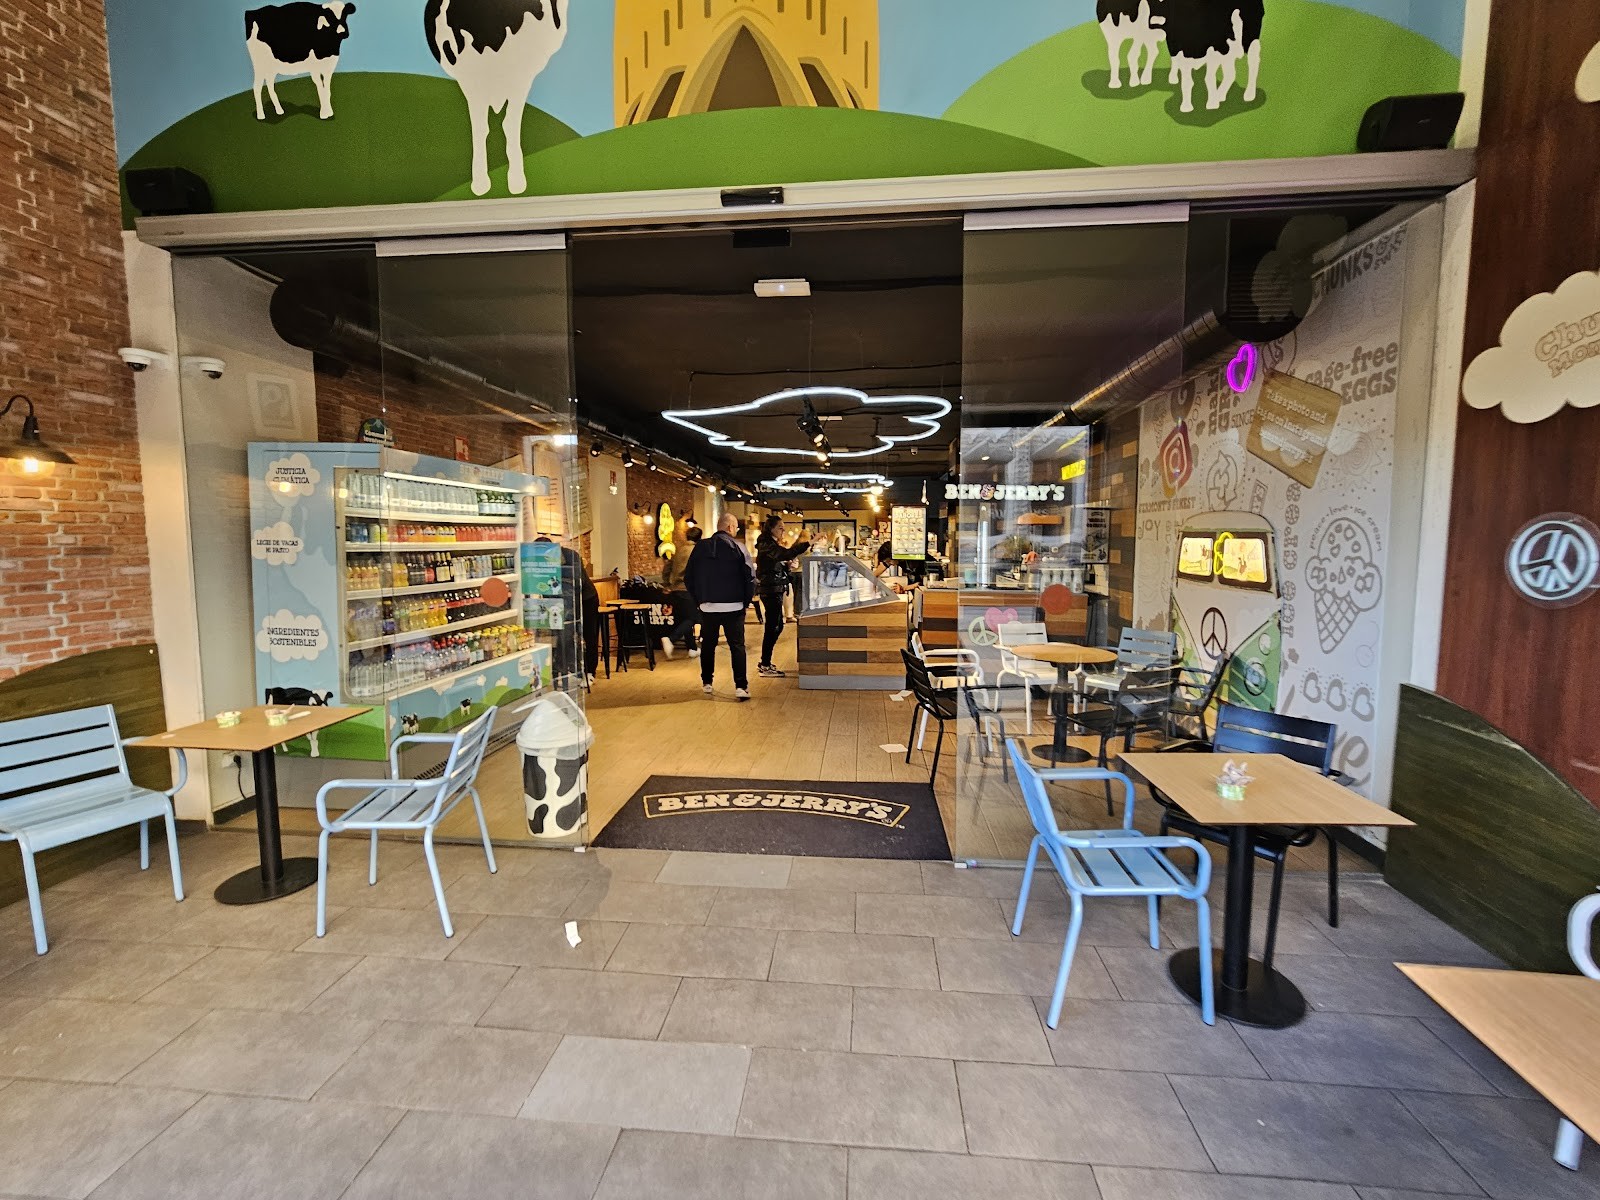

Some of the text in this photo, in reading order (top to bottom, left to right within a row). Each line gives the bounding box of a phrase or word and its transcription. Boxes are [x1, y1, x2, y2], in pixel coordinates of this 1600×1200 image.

[1340, 366, 1398, 406] EGGS
[1310, 411, 1328, 425] and
[275, 467, 306, 475] JUSTICIA
[1328, 504, 1349, 517] love
[267, 627, 320, 637] INGREDIENTES
[269, 637, 317, 647] SOSTENIBLES
